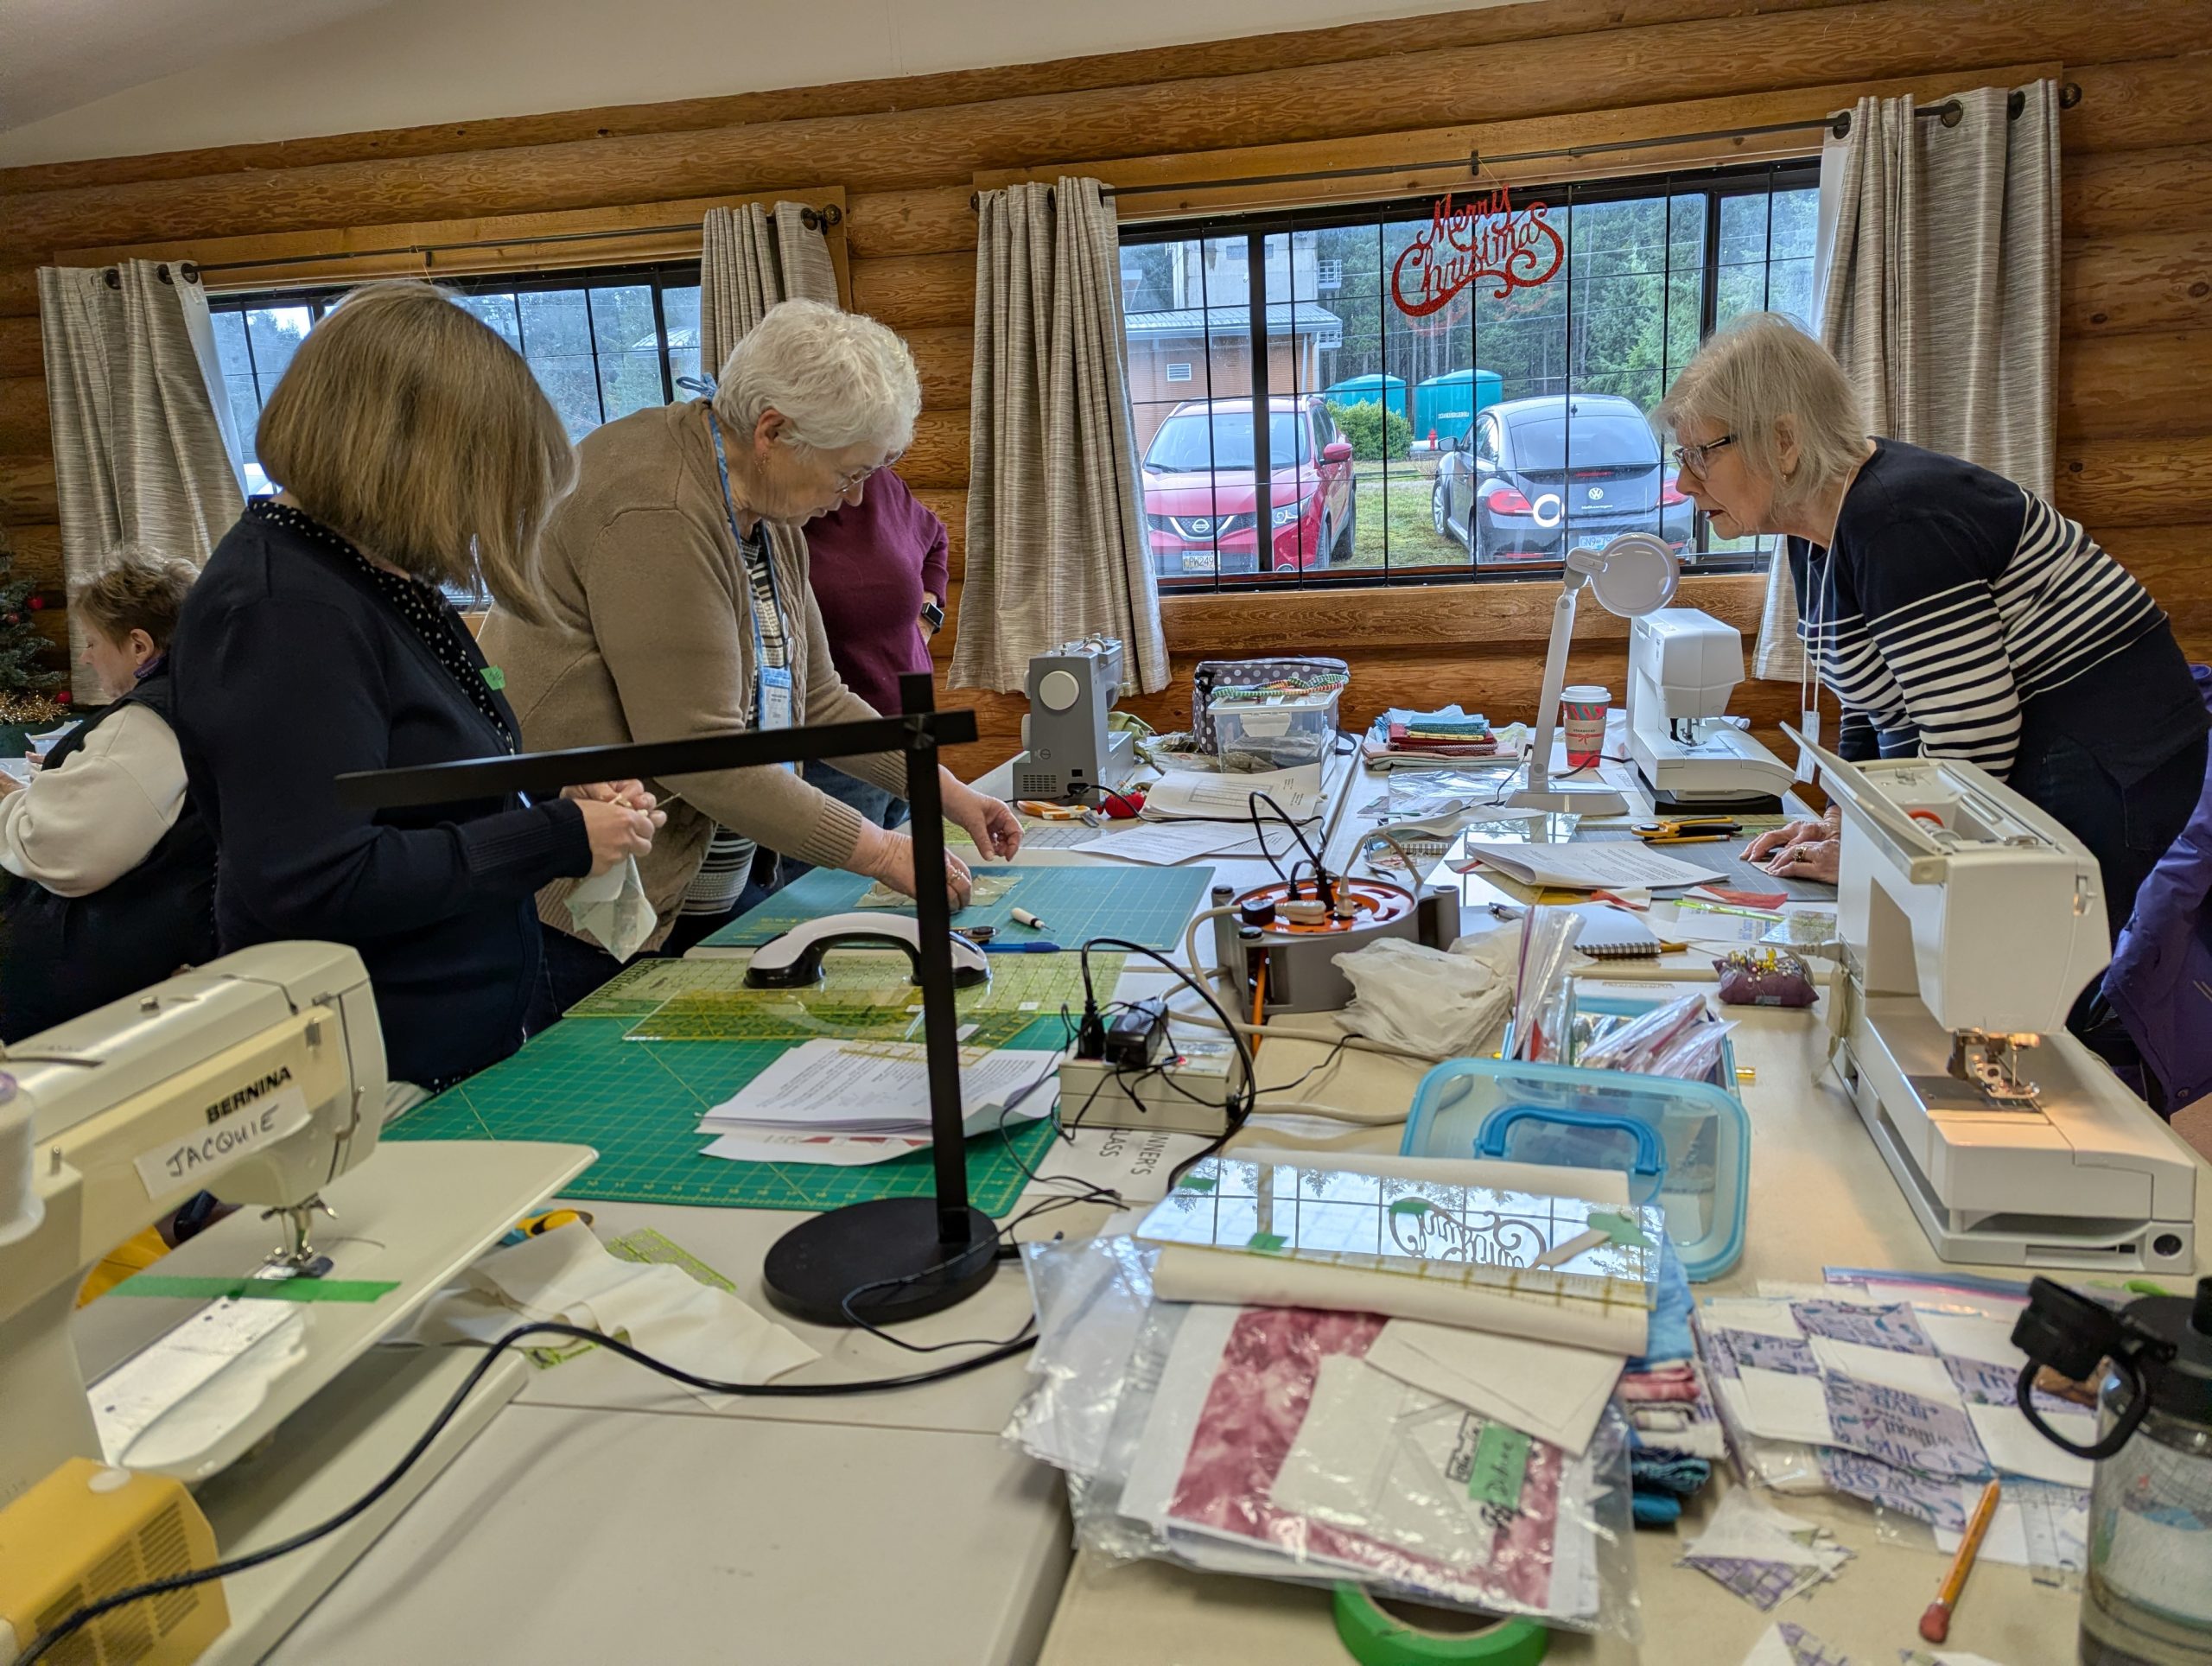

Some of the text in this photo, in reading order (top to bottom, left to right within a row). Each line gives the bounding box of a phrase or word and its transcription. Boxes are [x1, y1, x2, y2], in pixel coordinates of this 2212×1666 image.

[1418, 184, 1512, 252] Merry
[1391, 201, 1565, 317] Christmas
[206, 1065, 293, 1124] BERNINA
[166, 1104, 279, 1177] JACQUIE
[1099, 1129, 1132, 1157] LASS
